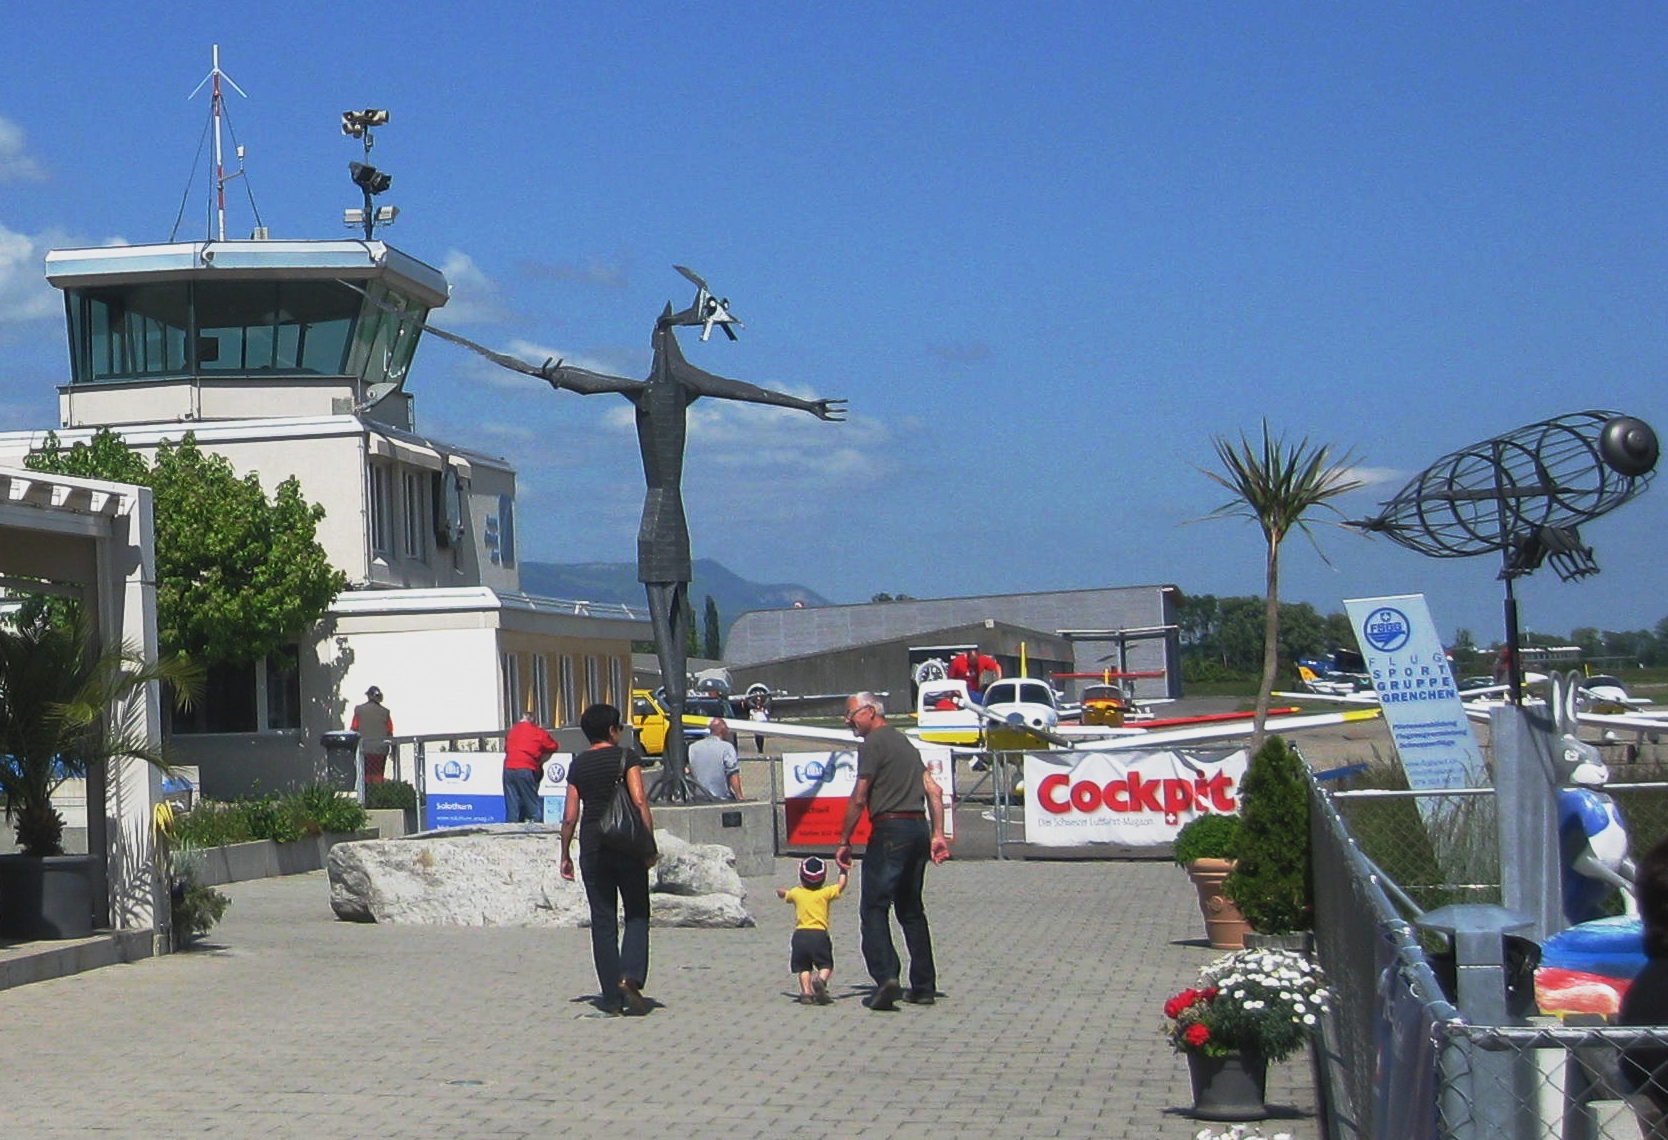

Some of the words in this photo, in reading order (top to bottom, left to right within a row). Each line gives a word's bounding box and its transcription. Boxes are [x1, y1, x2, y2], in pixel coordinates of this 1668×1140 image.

[1369, 652, 1443, 667] FLUG
[1373, 664, 1447, 680] SPORT
[1376, 676, 1451, 692] GRUPPE
[1381, 689, 1454, 703] GRENCHEN
[1036, 767, 1237, 826] Cockpit
